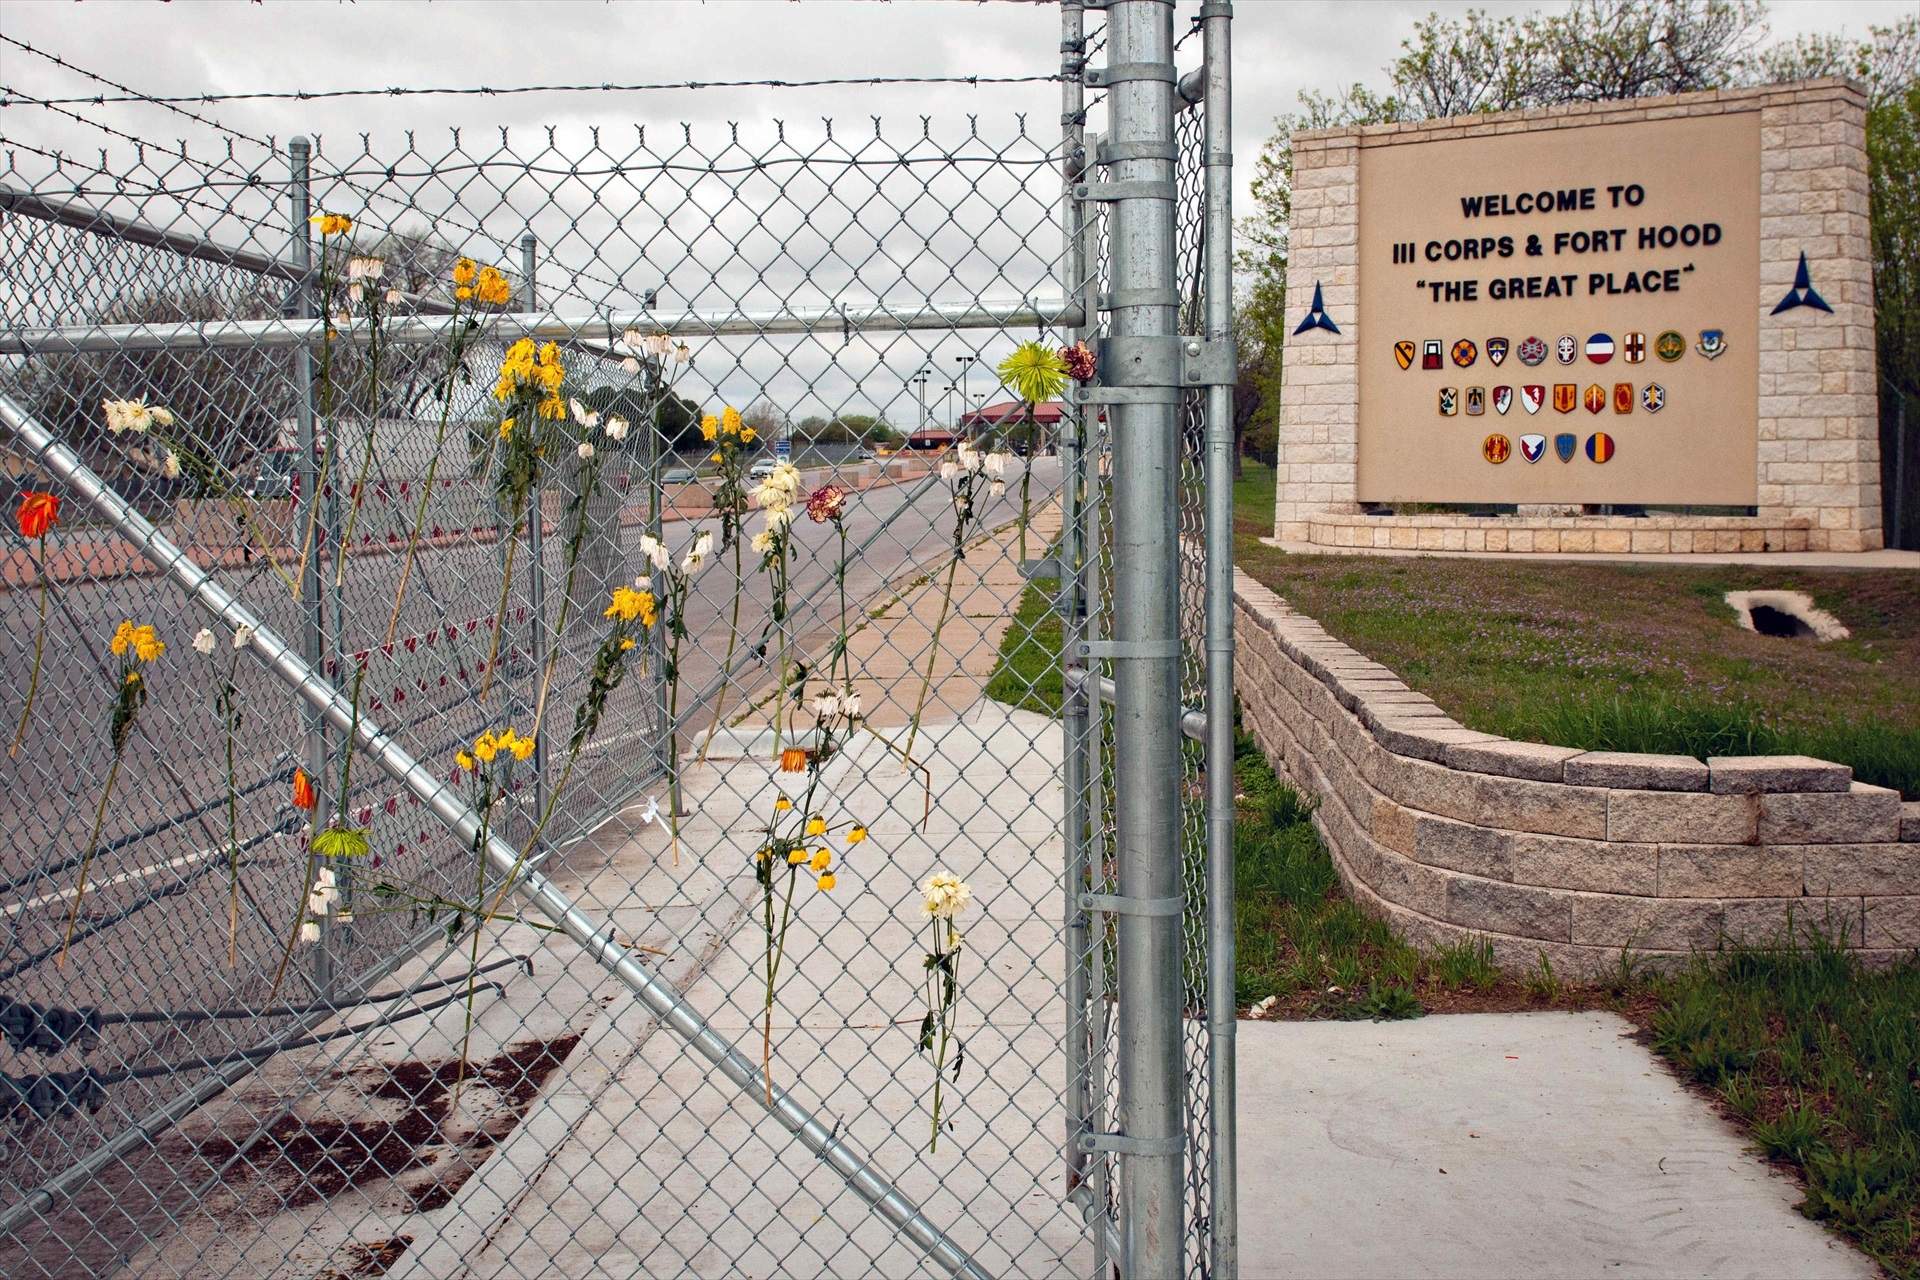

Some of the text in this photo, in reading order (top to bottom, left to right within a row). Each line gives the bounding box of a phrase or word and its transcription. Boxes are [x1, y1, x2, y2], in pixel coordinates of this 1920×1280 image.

[1460, 183, 1646, 219] WELCOME TO
[1392, 222, 1723, 265] III CORPS & FORT HOOD
[1416, 279, 1479, 303] “THE
[1488, 274, 1579, 301] GREAT
